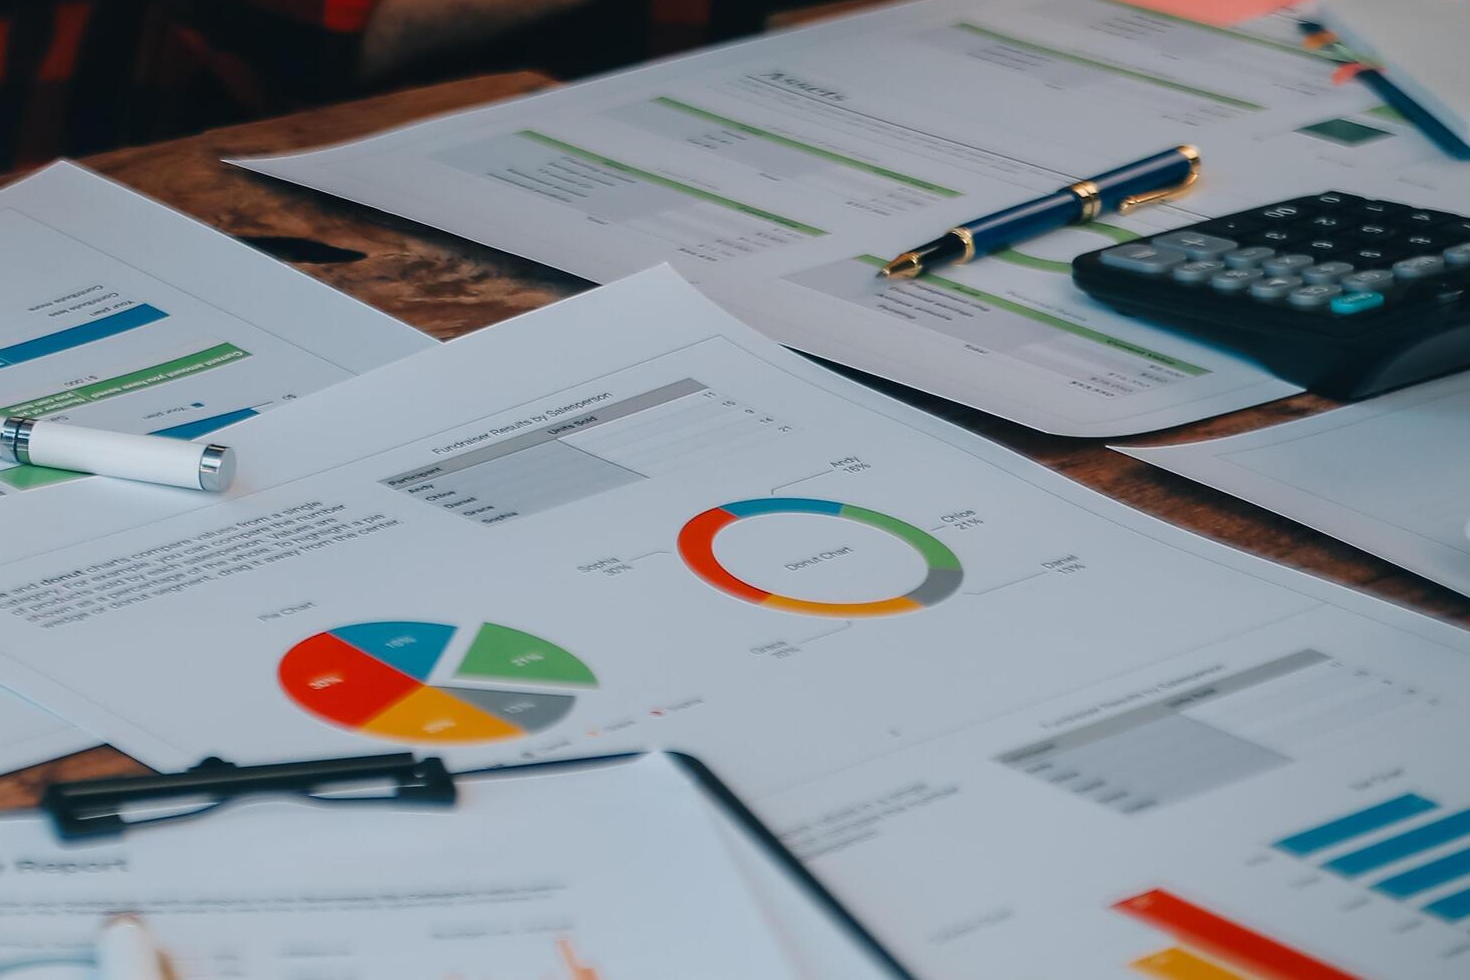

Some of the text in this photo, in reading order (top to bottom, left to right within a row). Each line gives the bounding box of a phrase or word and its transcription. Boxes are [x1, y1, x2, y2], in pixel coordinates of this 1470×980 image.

[431, 393, 613, 455] Fundraiser Results by Salesperson
[547, 416, 598, 434] Units Sold
[830, 454, 862, 470] Andy
[940, 507, 977, 525] Chloe
[954, 515, 984, 531] 21%
[10, 582, 40, 595] and
[40, 570, 87, 585] donut
[80, 558, 132, 572] charts
[126, 540, 193, 559] compare
[191, 525, 245, 541] values
[234, 517, 274, 528] from
[282, 501, 322, 515] single
[57, 579, 89, 589] For
[90, 561, 156, 581] example,
[154, 552, 184, 564] you
[178, 544, 212, 555] can
[211, 527, 277, 546] compare
[269, 519, 296, 529] the
[294, 504, 346, 522] number
[12, 518, 338, 616] of products sold by each salesperson. Values are
[26, 605, 76, 622] shown
[75, 600, 95, 608] as
[107, 573, 187, 599] percentage
[187, 567, 203, 575] of
[201, 561, 229, 570] the
[226, 547, 274, 562] whole.
[271, 540, 299, 548] To
[290, 524, 351, 543] highlight
[361, 514, 394, 523] pie
[784, 545, 855, 573] Donut Chart
[1041, 553, 1078, 571] Daniel
[12, 856, 128, 875] Report
